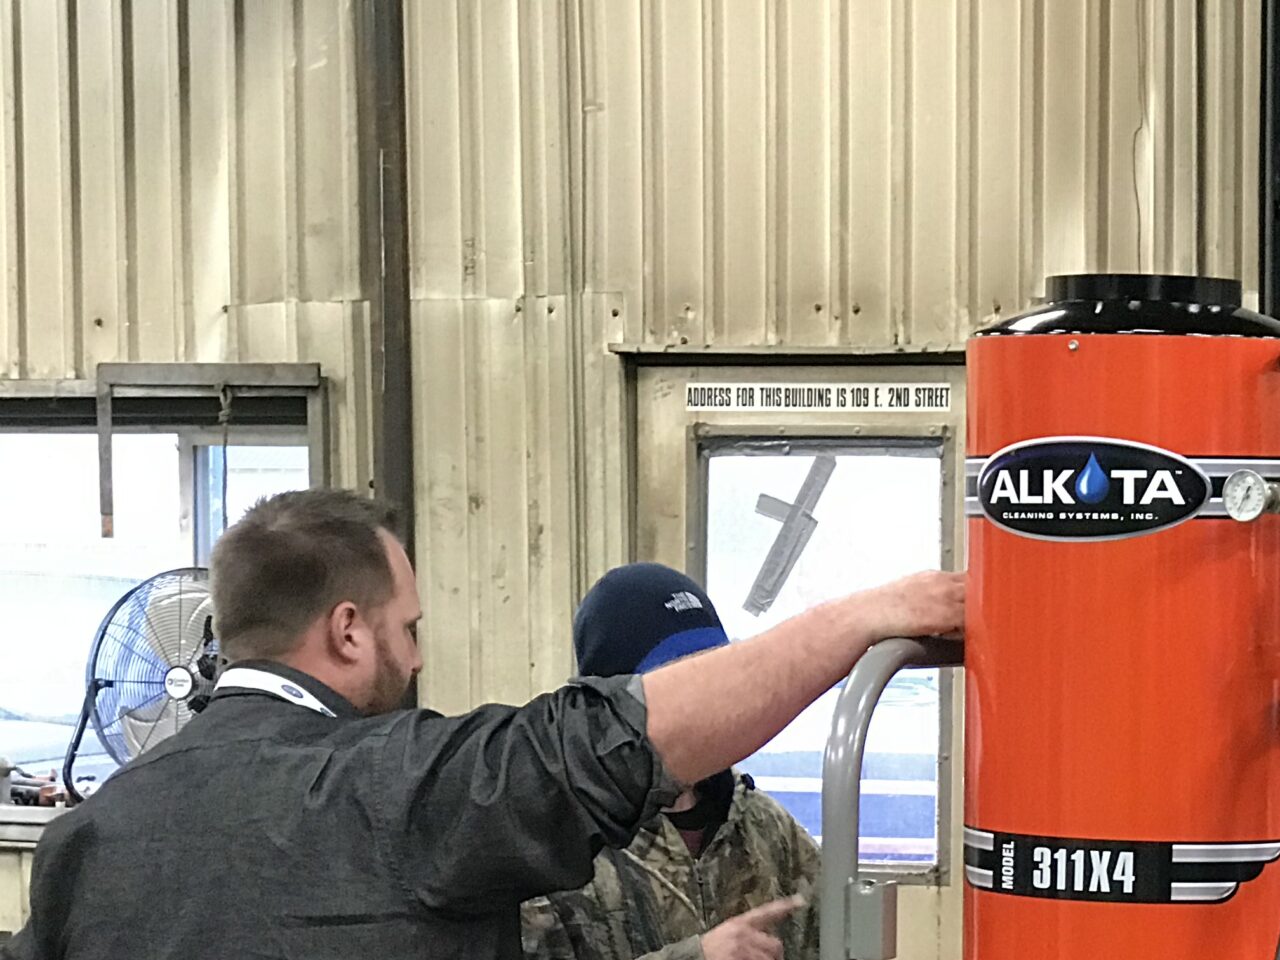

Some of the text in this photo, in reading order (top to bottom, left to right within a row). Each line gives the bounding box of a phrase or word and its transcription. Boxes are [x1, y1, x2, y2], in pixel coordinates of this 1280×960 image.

[686, 387, 732, 407] ADDRESS
[736, 387, 755, 407] FOR
[760, 387, 782, 407] THIS
[784, 387, 831, 408] BUILDING
[836, 388, 847, 408] IS
[850, 387, 869, 408] 109
[874, 387, 883, 408] E.
[888, 387, 910, 408] 2ND
[914, 387, 950, 408] STREET
[1002, 512, 1054, 520] CLEANING
[1059, 512, 1124, 521] SYSTEMS,
[1001, 841, 1015, 889] MODEL
[1032, 847, 1135, 893] 311X4
